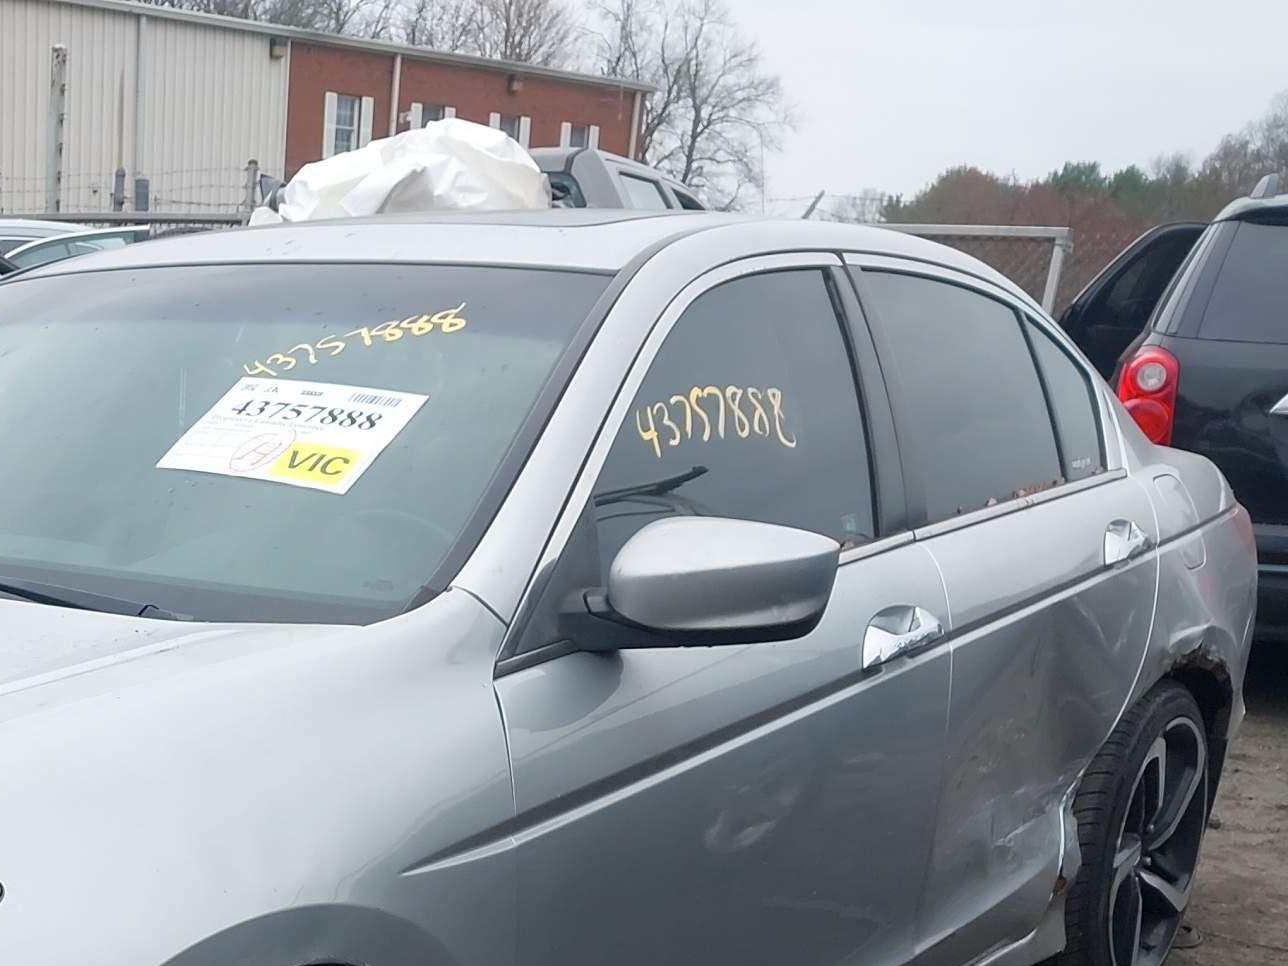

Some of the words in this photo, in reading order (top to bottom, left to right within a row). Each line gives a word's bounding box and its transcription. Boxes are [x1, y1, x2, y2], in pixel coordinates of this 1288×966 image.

[243, 302, 466, 376] 43757888
[232, 400, 383, 430] 43757888
[636, 385, 797, 458] 43757888
[288, 450, 350, 475] VIC
